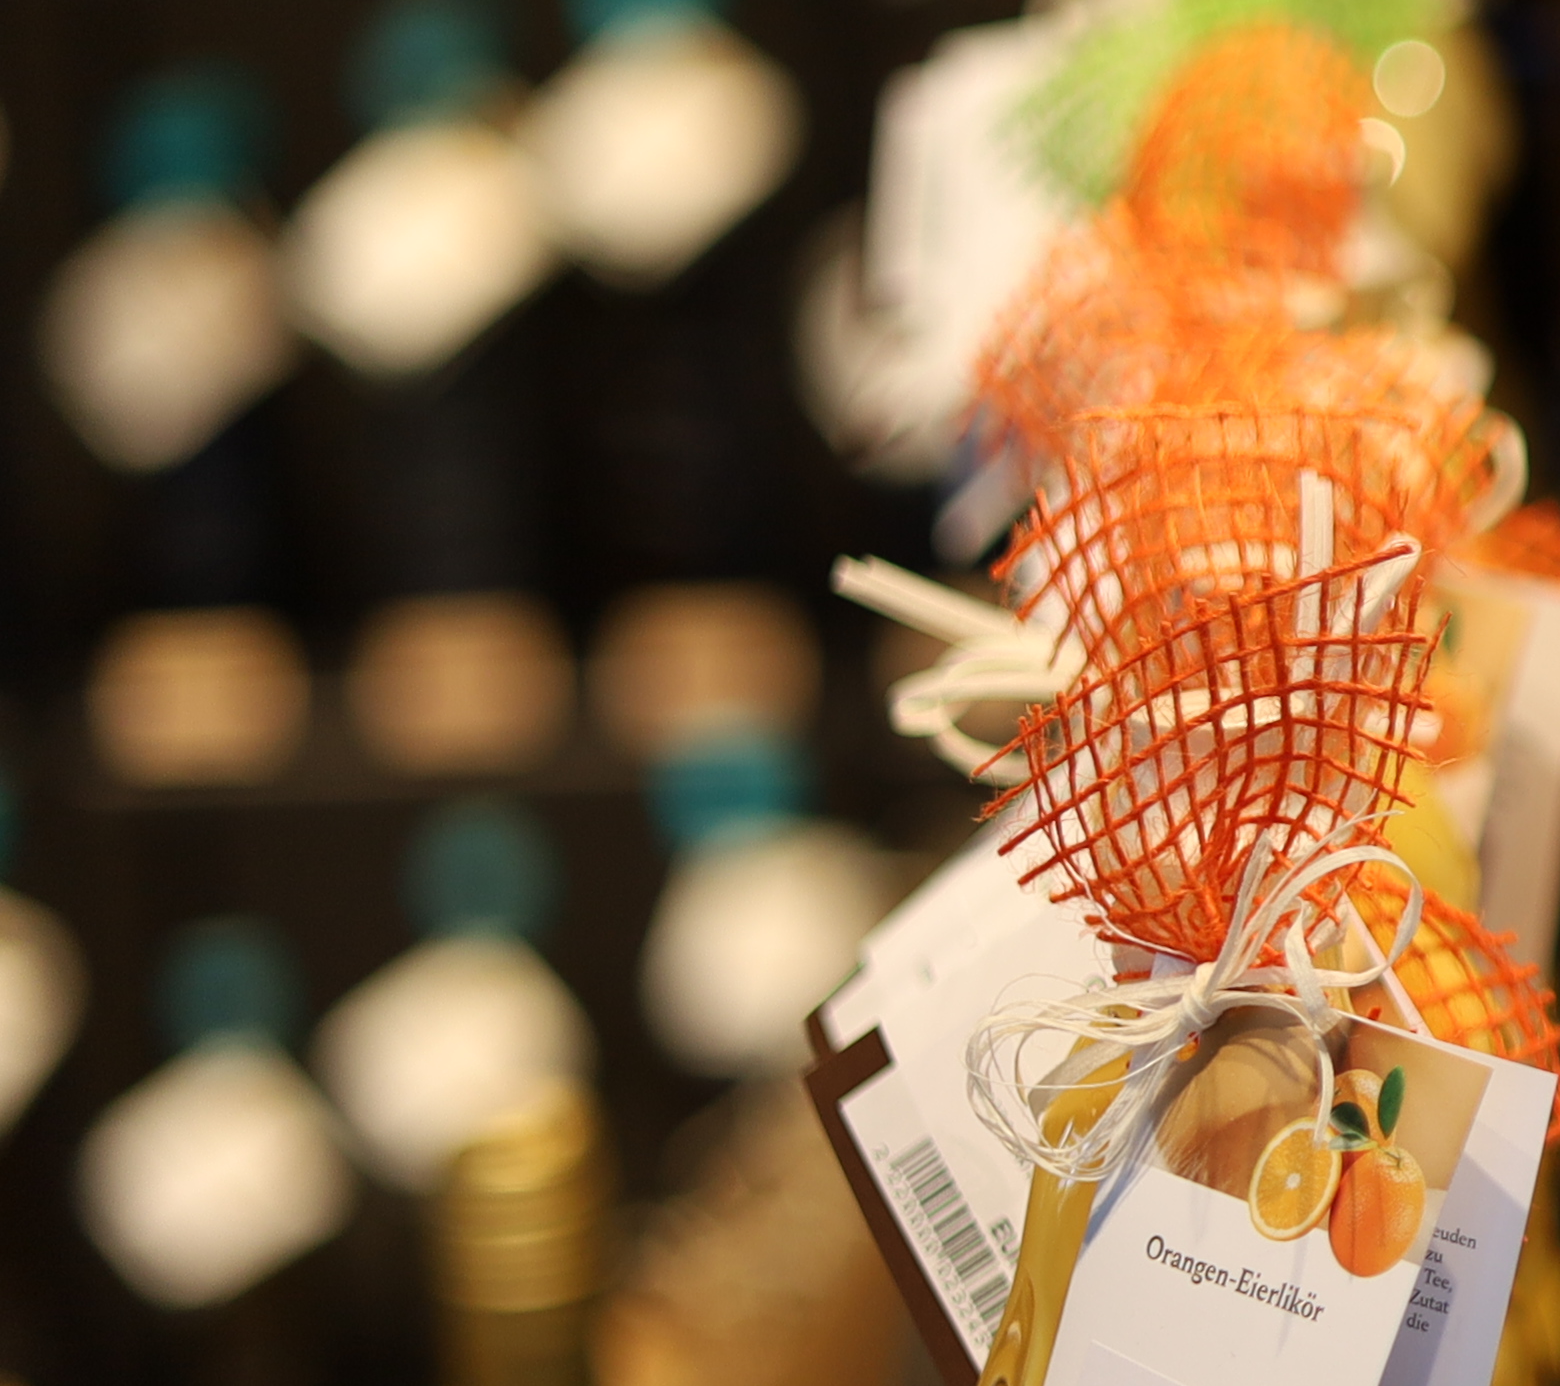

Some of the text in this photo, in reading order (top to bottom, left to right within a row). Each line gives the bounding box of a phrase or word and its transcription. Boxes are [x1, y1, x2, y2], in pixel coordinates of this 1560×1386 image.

[1145, 1234, 1326, 1323] Orangen-Eierlikör
[1424, 1267, 1454, 1293] Tee,
[1409, 1288, 1451, 1315] Zutat
[1406, 1312, 1430, 1333] die
